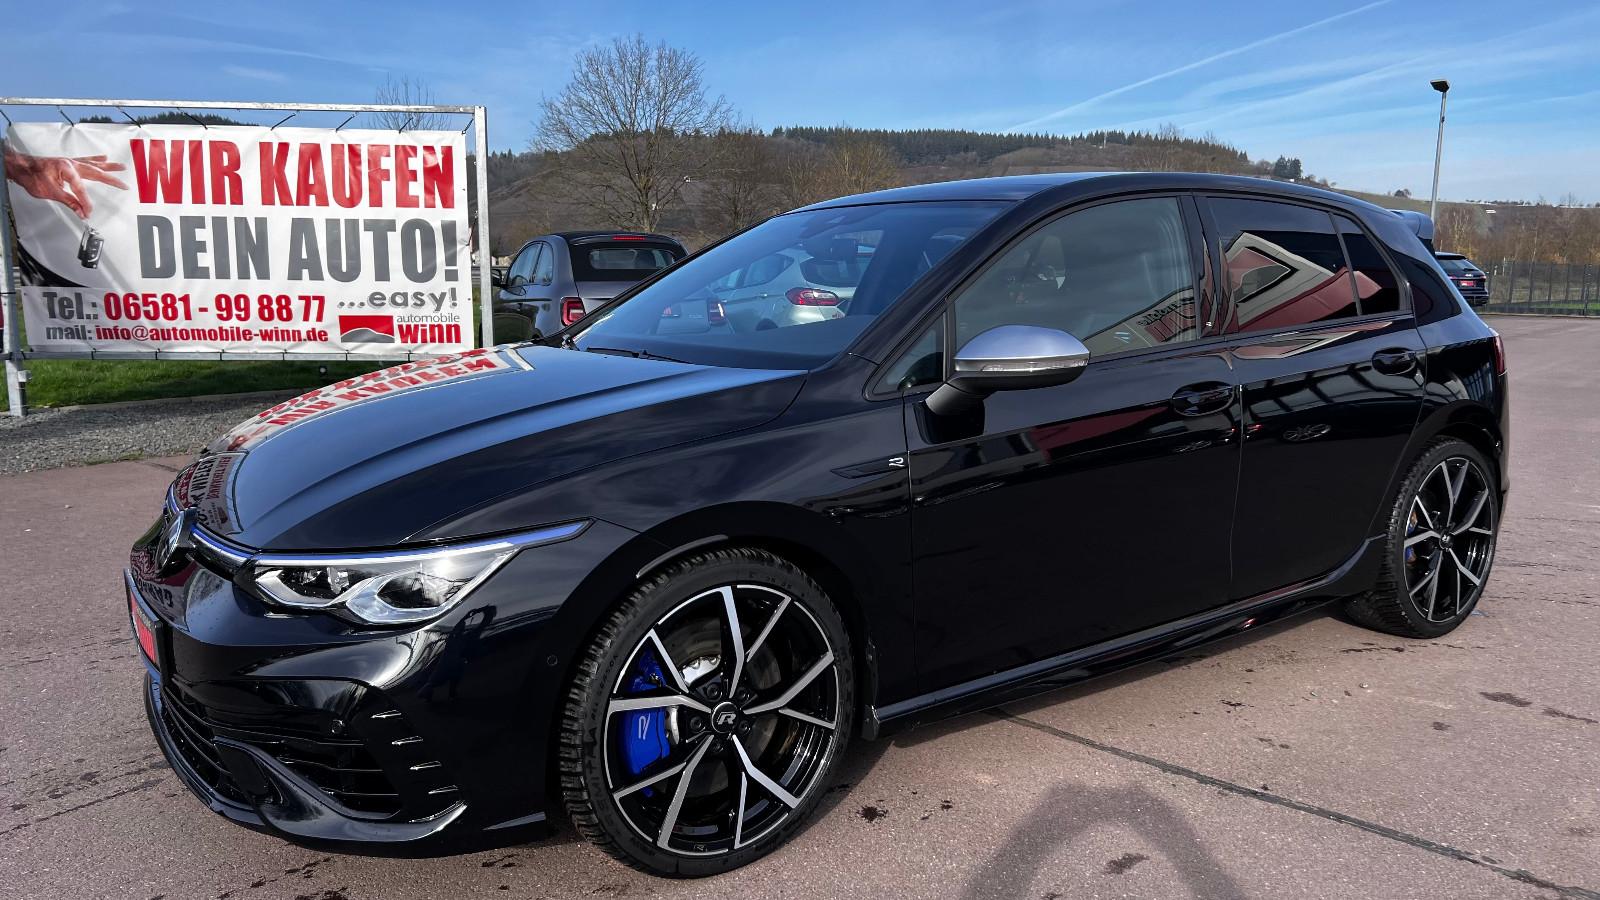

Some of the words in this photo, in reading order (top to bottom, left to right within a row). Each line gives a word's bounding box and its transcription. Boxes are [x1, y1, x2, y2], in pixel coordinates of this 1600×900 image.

[129, 139, 244, 206] WIR
[258, 141, 455, 209] KAUFEN
[136, 214, 271, 280] DEIN
[287, 217, 459, 283] AUTO!
[42, 291, 99, 320] Tel.:
[103, 292, 193, 321] 06581
[214, 293, 251, 322] 99
[257, 294, 294, 323] 88
[298, 295, 326, 323] 77
[337, 287, 459, 313] ...easy!
[396, 313, 461, 323] automobile
[45, 325, 94, 340] mail:
[95, 325, 329, 342] info@automobile-winn.de
[397, 323, 462, 344] winn
[716, 711, 737, 725] R
